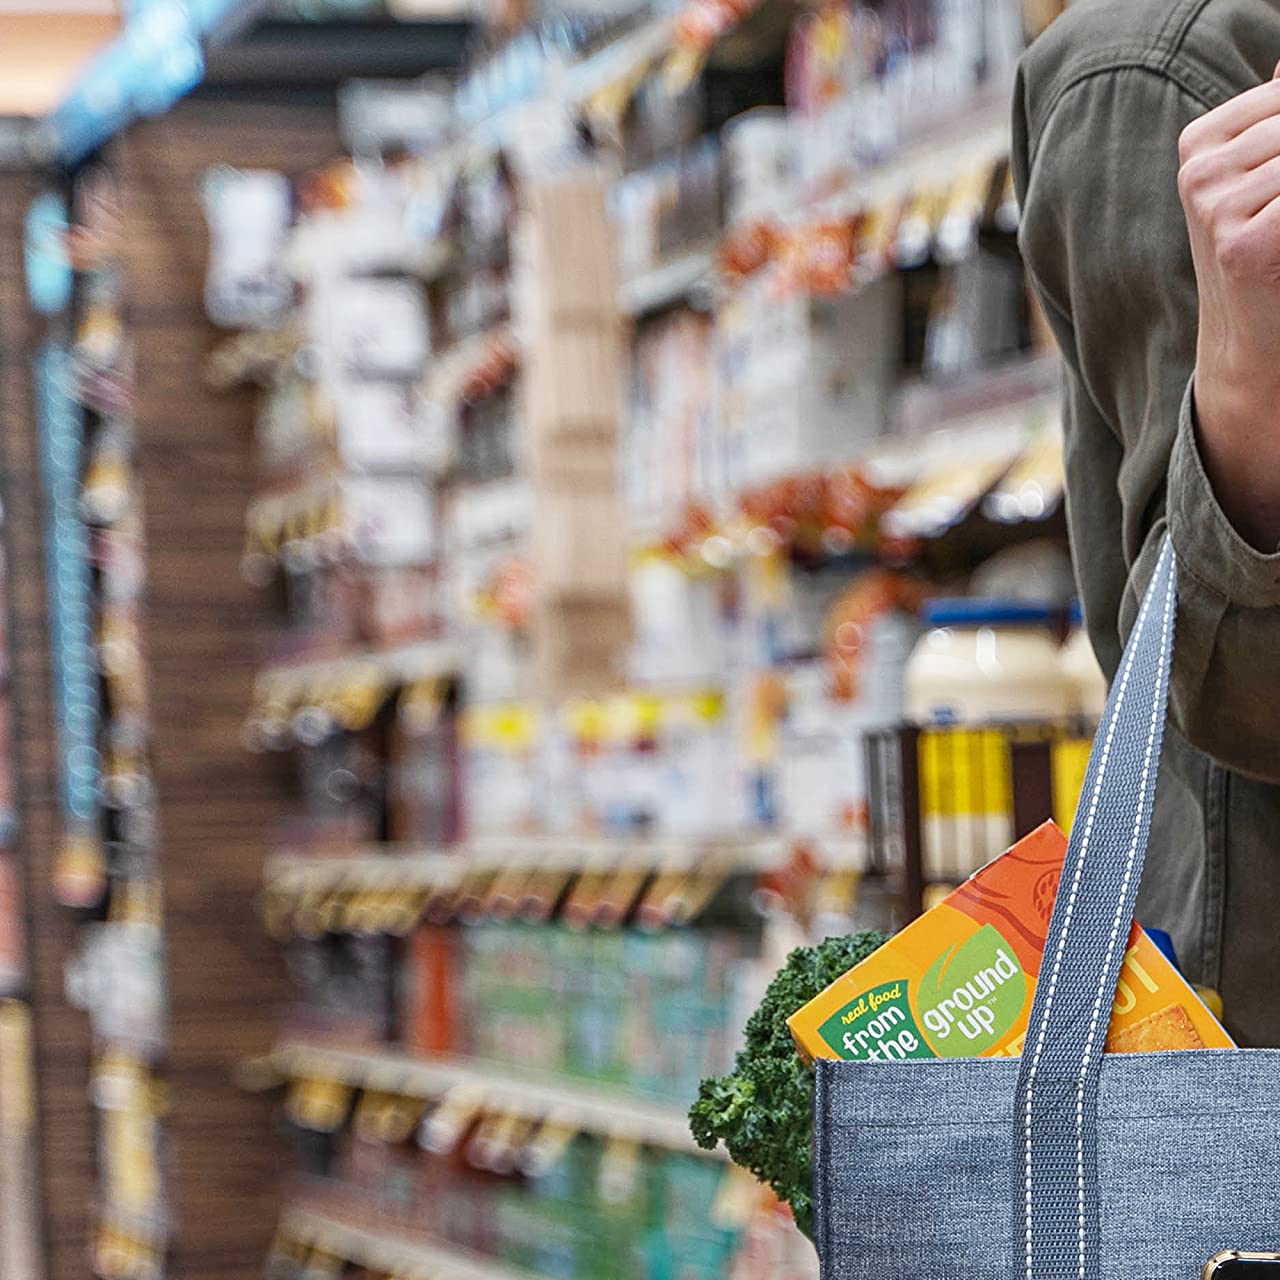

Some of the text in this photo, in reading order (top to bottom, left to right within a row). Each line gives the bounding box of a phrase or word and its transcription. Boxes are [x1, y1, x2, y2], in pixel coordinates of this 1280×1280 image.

[841, 984, 902, 1026] real food
[922, 947, 1018, 1041] ground
[842, 1004, 907, 1056] from
[957, 1002, 996, 1040] up
[867, 1027, 920, 1061] the
